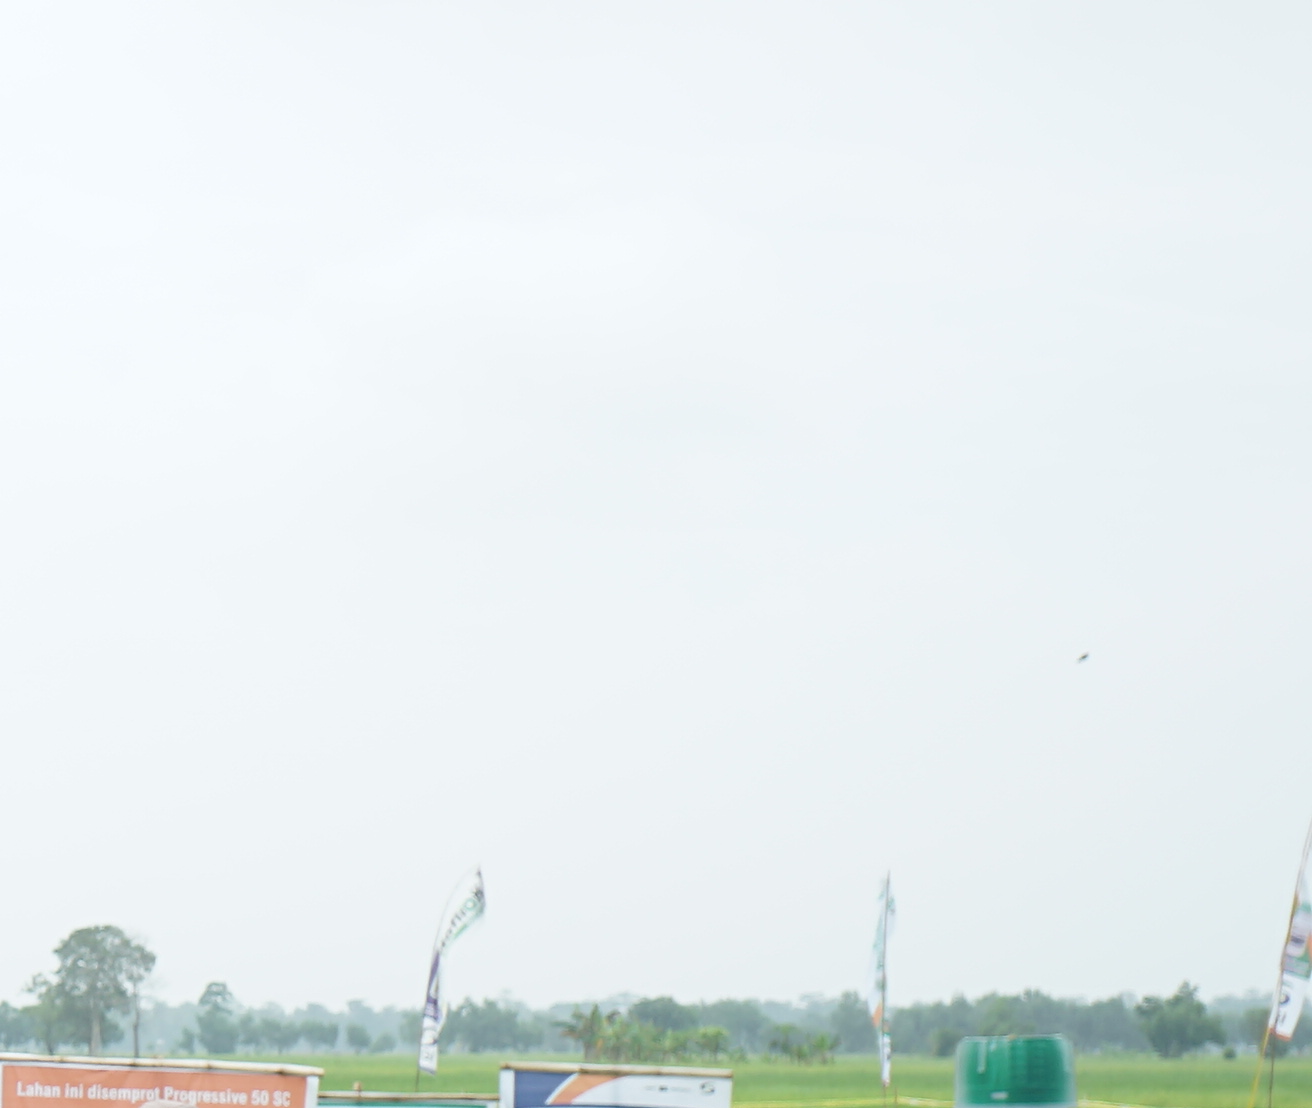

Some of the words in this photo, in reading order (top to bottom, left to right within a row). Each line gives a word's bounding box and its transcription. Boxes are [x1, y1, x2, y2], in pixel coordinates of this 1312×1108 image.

[17, 1081, 62, 1098] Lahan
[65, 1082, 84, 1099] ini
[87, 1083, 161, 1104] disemprot
[163, 1086, 248, 1106] Progressive
[251, 1089, 270, 1106] 50
[272, 1091, 291, 1107] SC
